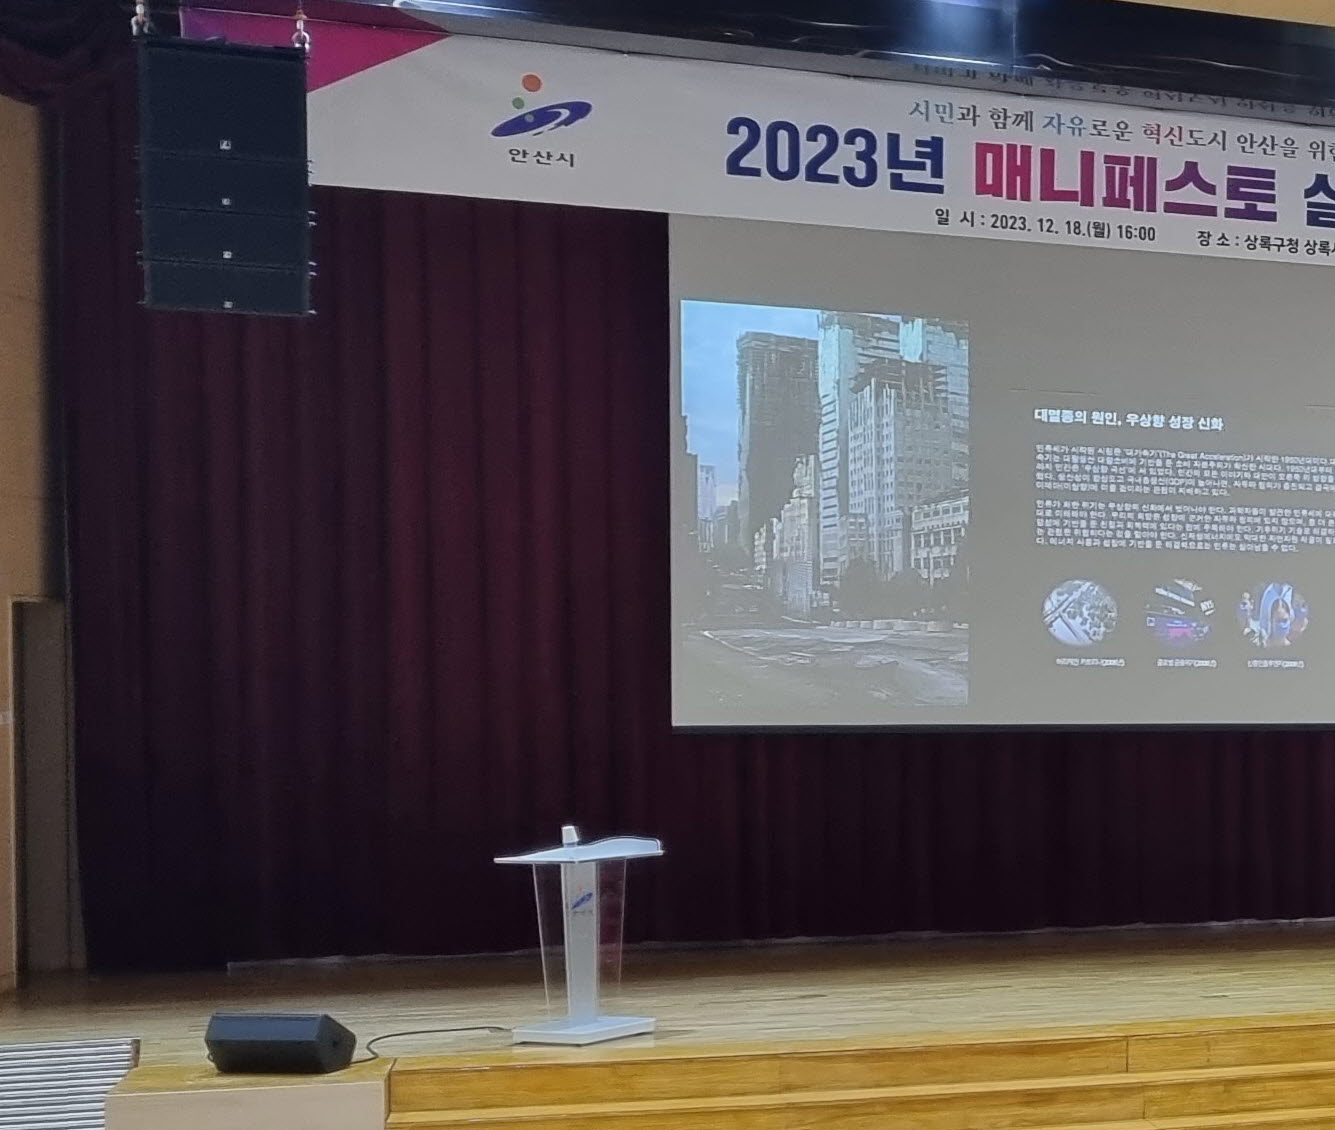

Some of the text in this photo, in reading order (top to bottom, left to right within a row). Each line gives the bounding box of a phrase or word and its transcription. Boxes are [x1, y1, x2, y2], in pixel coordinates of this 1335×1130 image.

[908, 99, 981, 128] 시민과
[988, 106, 1034, 133] 함께
[1041, 112, 1133, 142] 자유로운
[1141, 121, 1228, 153] 혁신도시
[1236, 133, 1300, 160] 안산을
[508, 148, 575, 168] 안산시
[725, 117, 945, 195] 2023년
[974, 141, 1278, 223] 매니페스토
[935, 208, 950, 226] 일
[990, 213, 1032, 233] 2023.
[1037, 218, 1059, 235] 12.
[1065, 219, 1111, 240] 18.(월)
[1117, 224, 1156, 242] 16:00
[1244, 235, 1299, 255] 상록구청
[1034, 408, 1225, 431] 대멸종의 원인, 우상향 성장 신화
